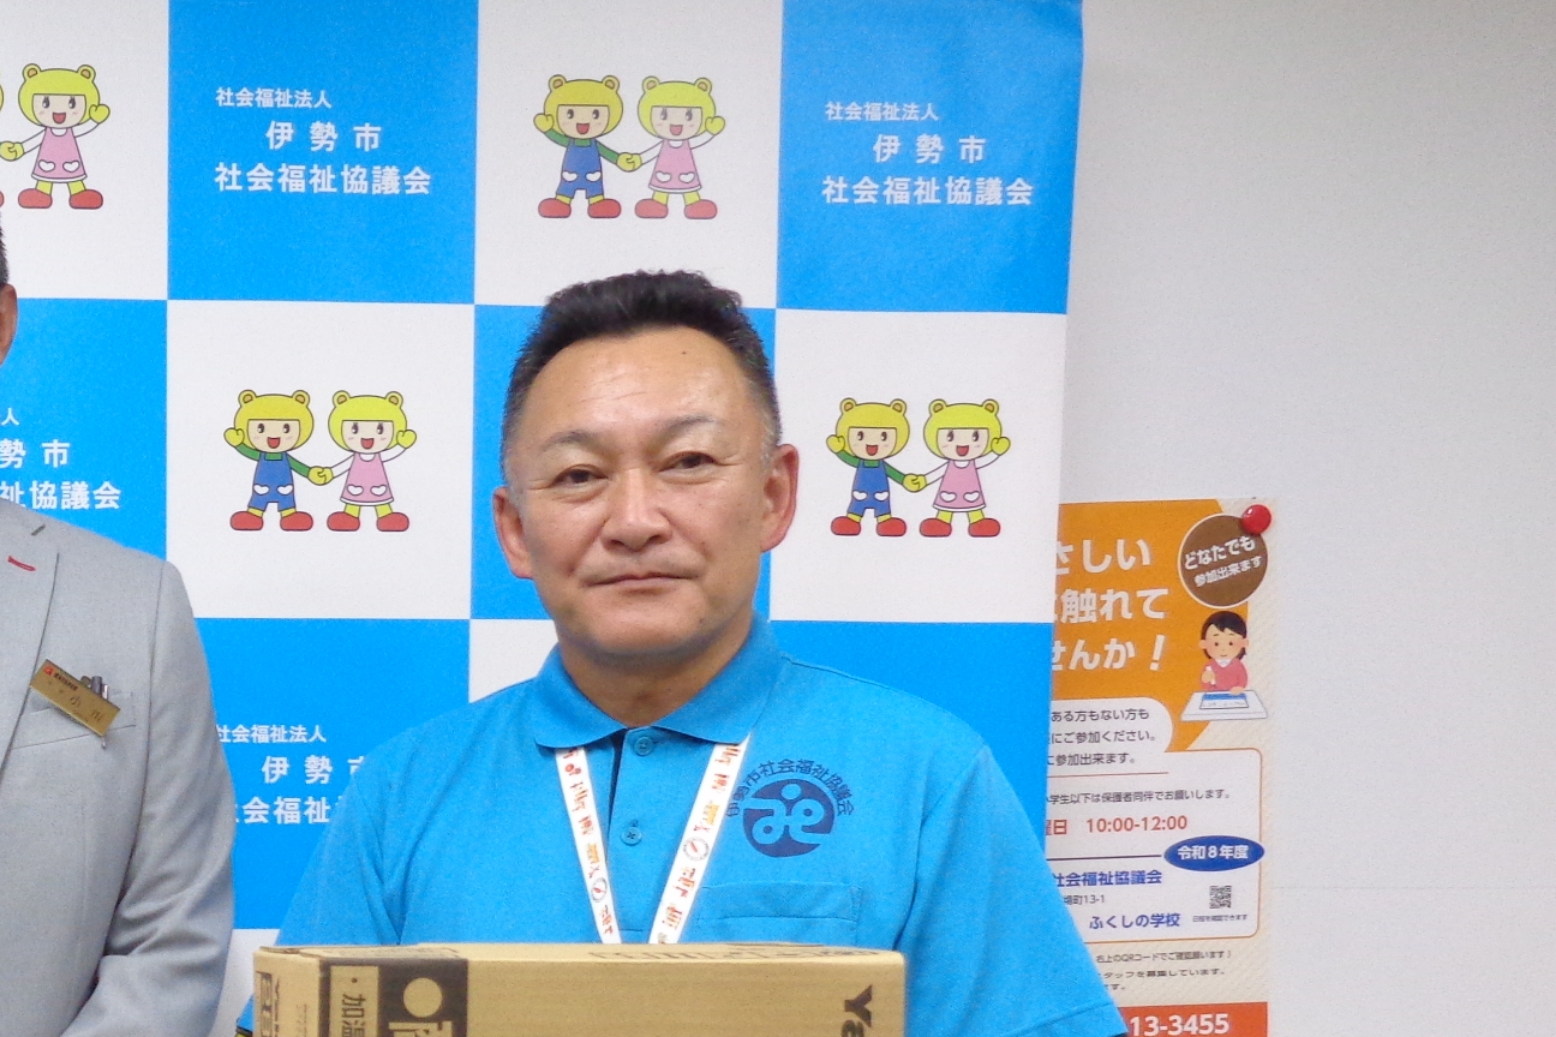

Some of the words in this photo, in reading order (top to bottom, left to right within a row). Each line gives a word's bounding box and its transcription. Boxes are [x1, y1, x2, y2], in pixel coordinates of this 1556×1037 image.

[215, 87, 332, 109] 社会福祉法人
[825, 101, 939, 122] 社会福祉法人
[266, 120, 382, 152] 伊勢市
[873, 133, 986, 164] 伊勢市
[215, 162, 432, 195] 社会福祉協議会
[822, 175, 1034, 206] 社会福祉協議会
[1185, 536, 1255, 570] どなたでも
[1195, 556, 1262, 587] 参加出来ます
[1051, 708, 1150, 722] ある方もない方も
[1047, 789, 1230, 805] 学生以下は保護者同伴でお願いします。
[1087, 815, 1188, 833] 10:00-12:00
[1178, 845, 1249, 860] 令和8年度
[1089, 913, 1180, 929] ふくしの学校
[1130, 1013, 1230, 1037] 13-3455
